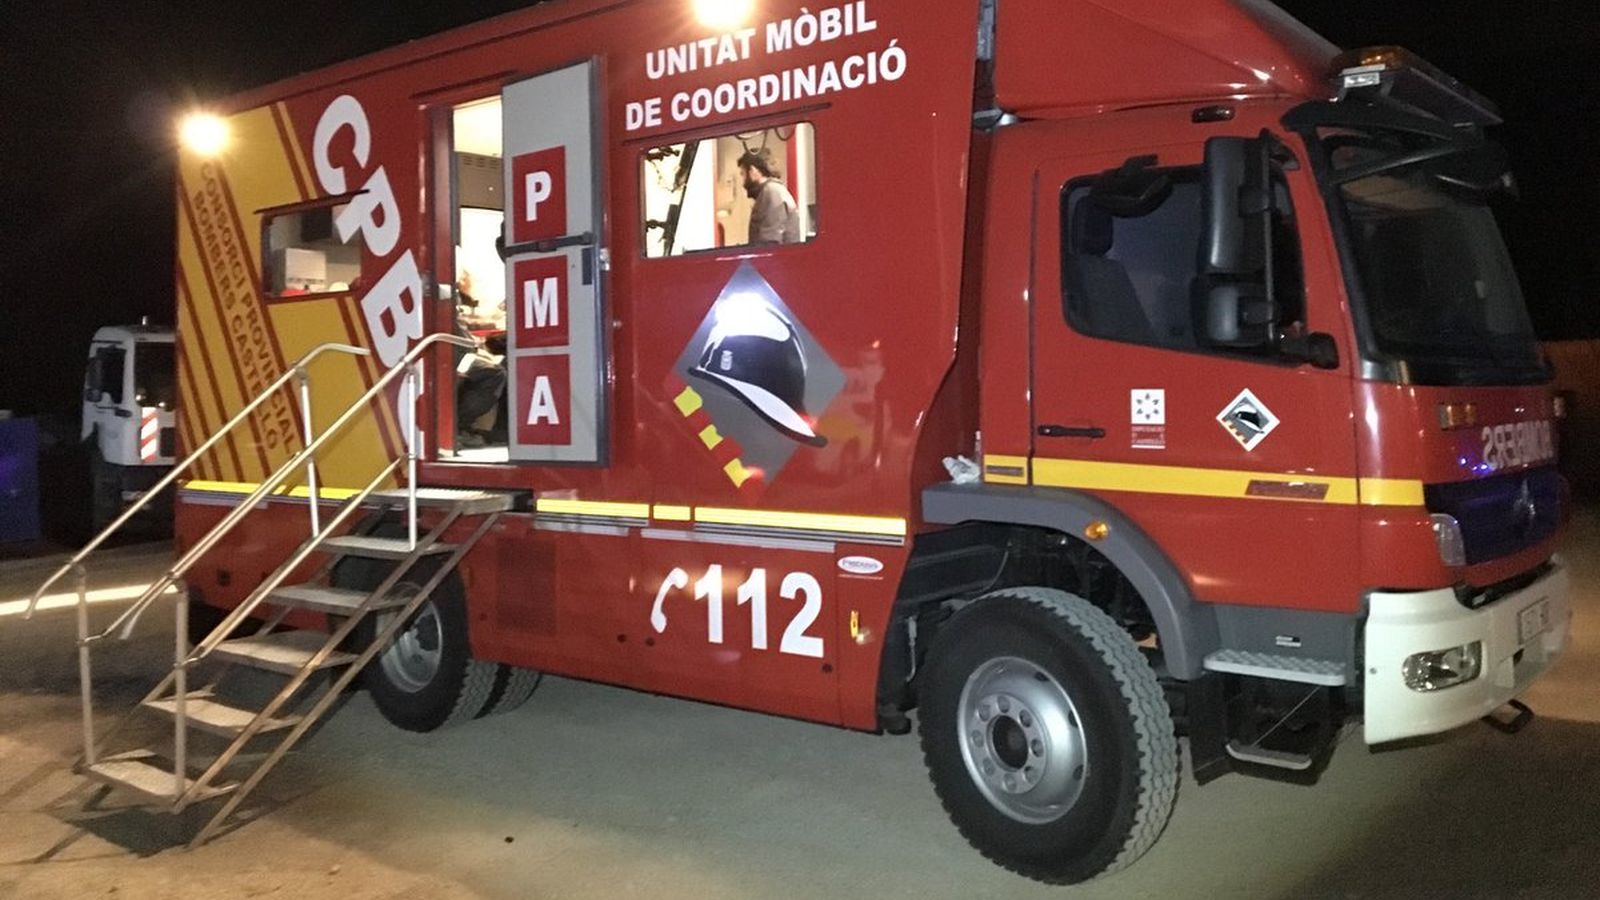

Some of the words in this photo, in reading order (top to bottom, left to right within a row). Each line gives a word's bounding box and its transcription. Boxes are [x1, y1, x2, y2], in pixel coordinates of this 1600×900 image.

[625, 98, 662, 131] DE
[671, 38, 907, 122] COORDINACIÓ
[646, 27, 756, 80] UNITAT
[765, 0, 877, 54] MÒBIL
[193, 190, 236, 310] BOMBERS
[201, 162, 247, 289] CONSORCI
[694, 564, 824, 658] 112
